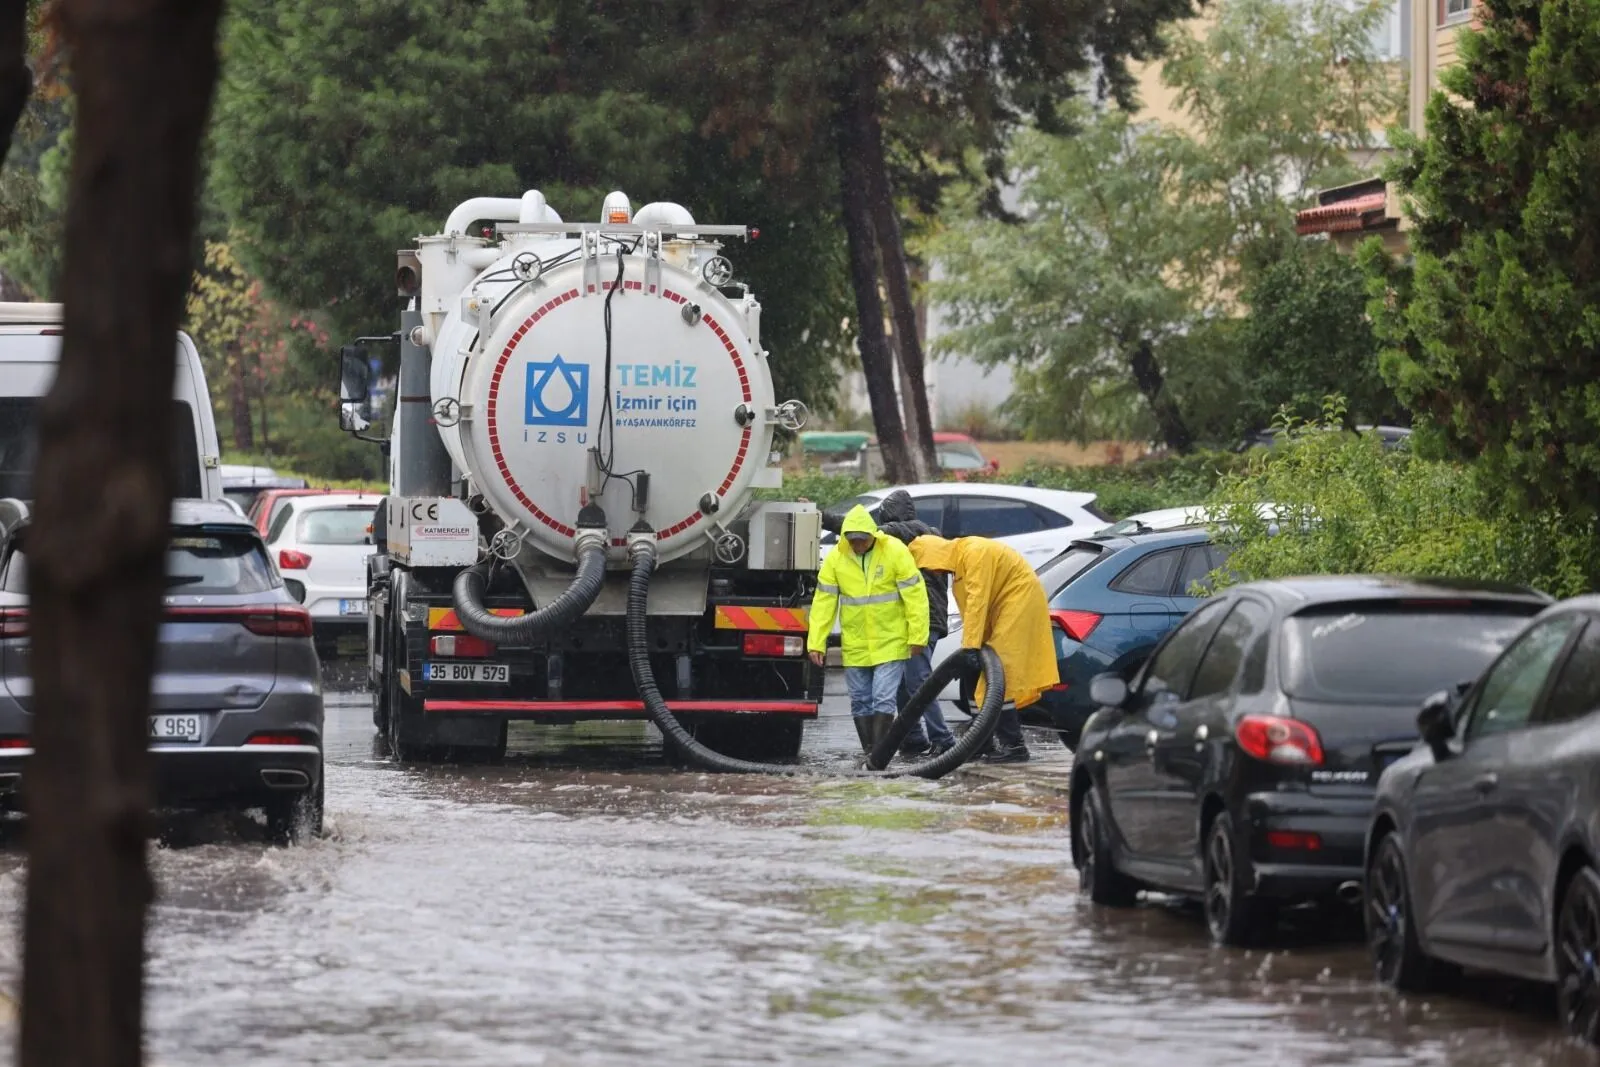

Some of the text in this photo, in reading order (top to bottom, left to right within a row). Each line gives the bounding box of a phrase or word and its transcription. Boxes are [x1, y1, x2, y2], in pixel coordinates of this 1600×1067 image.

[616, 360, 697, 388] TEMİZ
[616, 390, 697, 412] İzmir için
[616, 417, 697, 428] #YAŞAYANKÖRFEZ
[524, 429, 587, 444] İZSU
[430, 665, 506, 680] 35 BOV 579
[166, 718, 197, 736] 969
